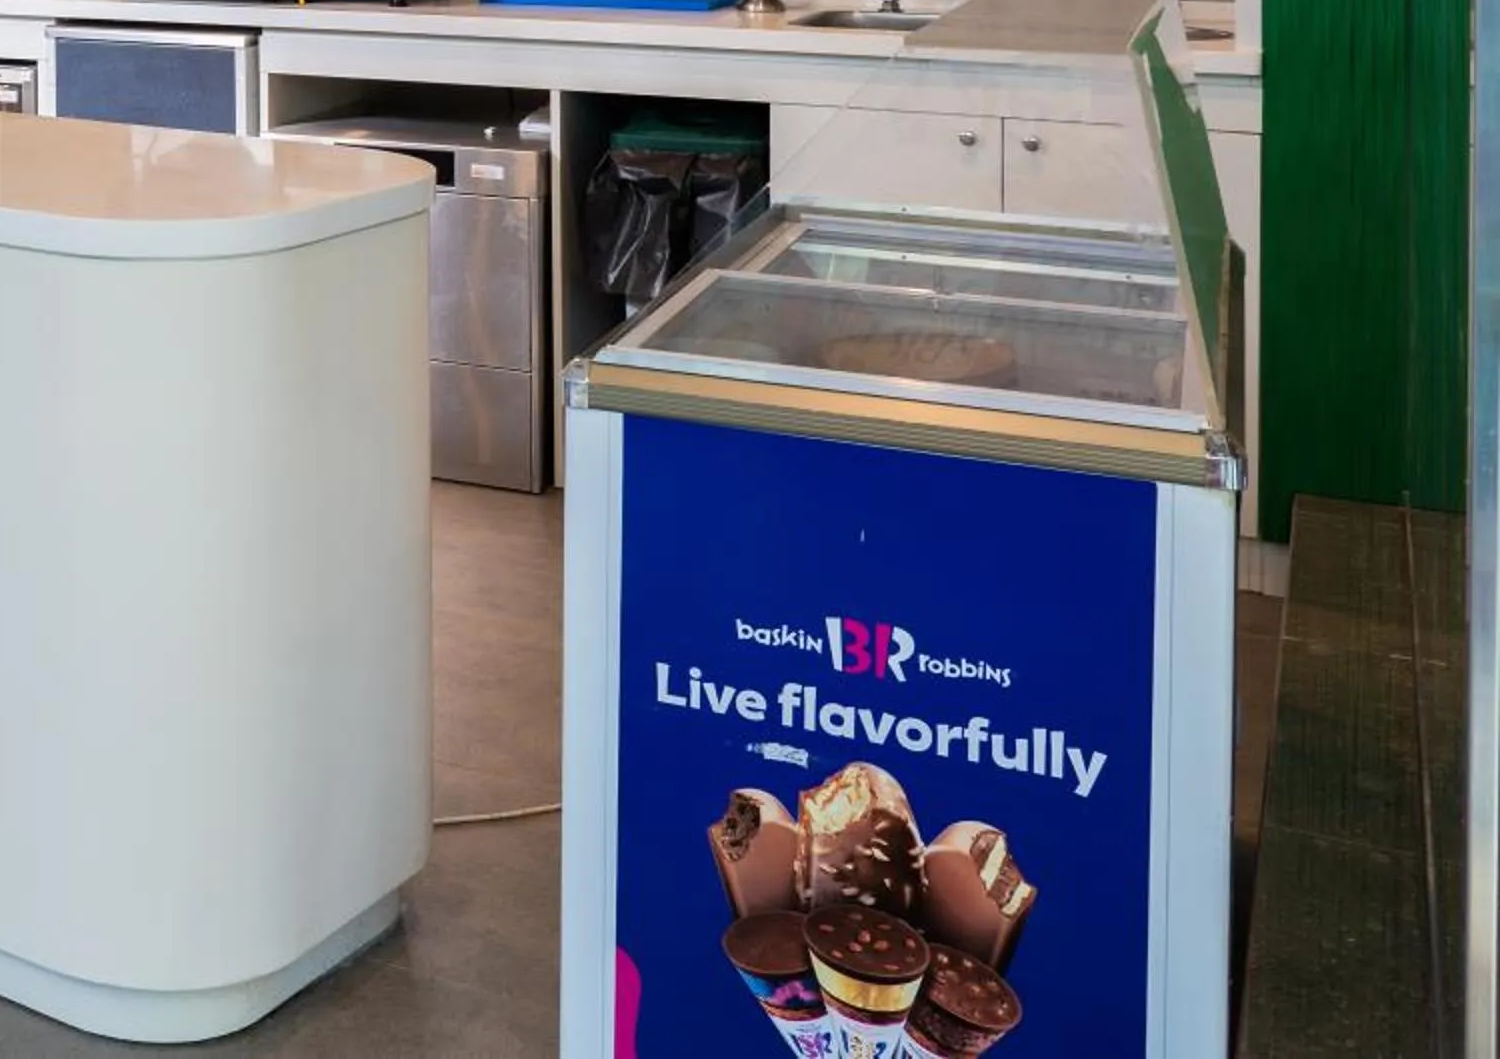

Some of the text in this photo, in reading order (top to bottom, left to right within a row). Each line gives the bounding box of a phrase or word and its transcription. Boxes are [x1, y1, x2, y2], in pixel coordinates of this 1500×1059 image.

[735, 616, 1012, 688] baskin BR robbins
[655, 662, 1108, 799] Live flavorfully
